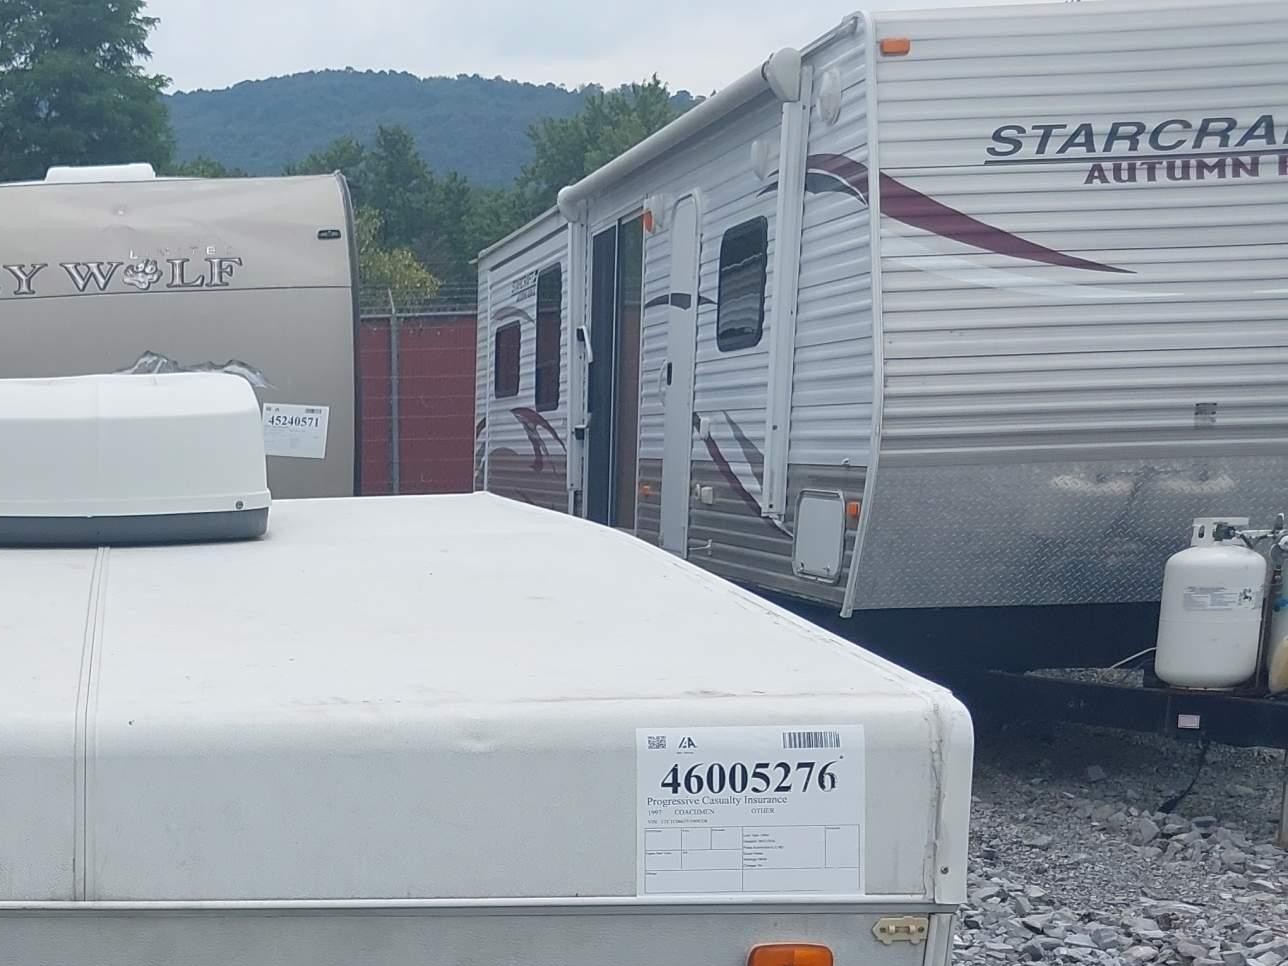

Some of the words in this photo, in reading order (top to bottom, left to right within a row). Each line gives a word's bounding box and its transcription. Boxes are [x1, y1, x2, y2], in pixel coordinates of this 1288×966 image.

[985, 114, 1288, 157] STARCRA
[1083, 155, 1260, 185] AUTUMN
[268, 415, 320, 428] 45240571
[660, 760, 839, 795] 46005276
[647, 797, 700, 807] Progressive
[702, 796, 742, 806] Casualty
[744, 795, 788, 804] Insurance
